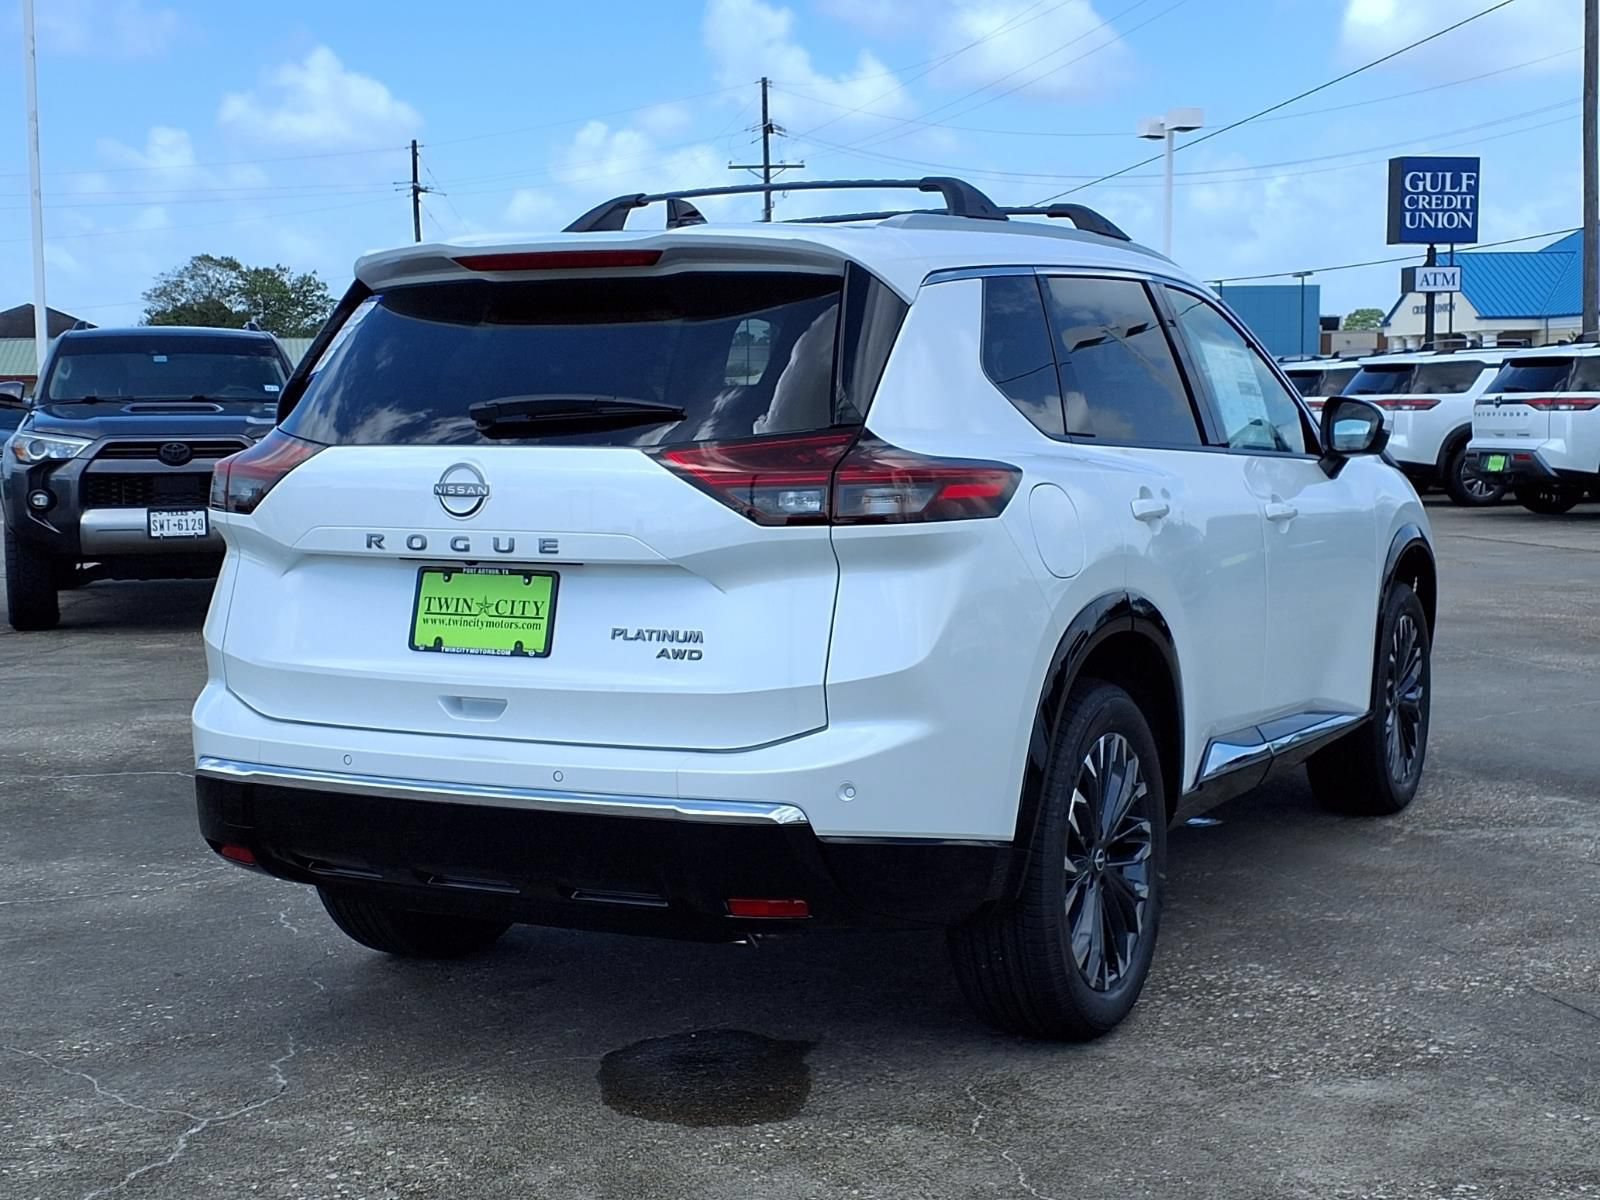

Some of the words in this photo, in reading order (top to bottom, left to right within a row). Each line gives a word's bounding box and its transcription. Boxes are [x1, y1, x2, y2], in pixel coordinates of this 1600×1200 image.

[1404, 171, 1477, 193] GULF
[1403, 194, 1475, 210] CREDIT
[1404, 211, 1474, 229] UNION
[1420, 271, 1456, 287] ATM
[434, 484, 488, 496] NISSAN
[366, 533, 560, 555] ROGUE
[424, 596, 474, 613] TWIN
[495, 599, 545, 616] CITY
[422, 616, 542, 631] www.twincitymotors.com
[610, 627, 704, 644] PLATINUM
[441, 647, 511, 655] TWINCITYMOTORS.COM
[656, 647, 703, 661] AWD
